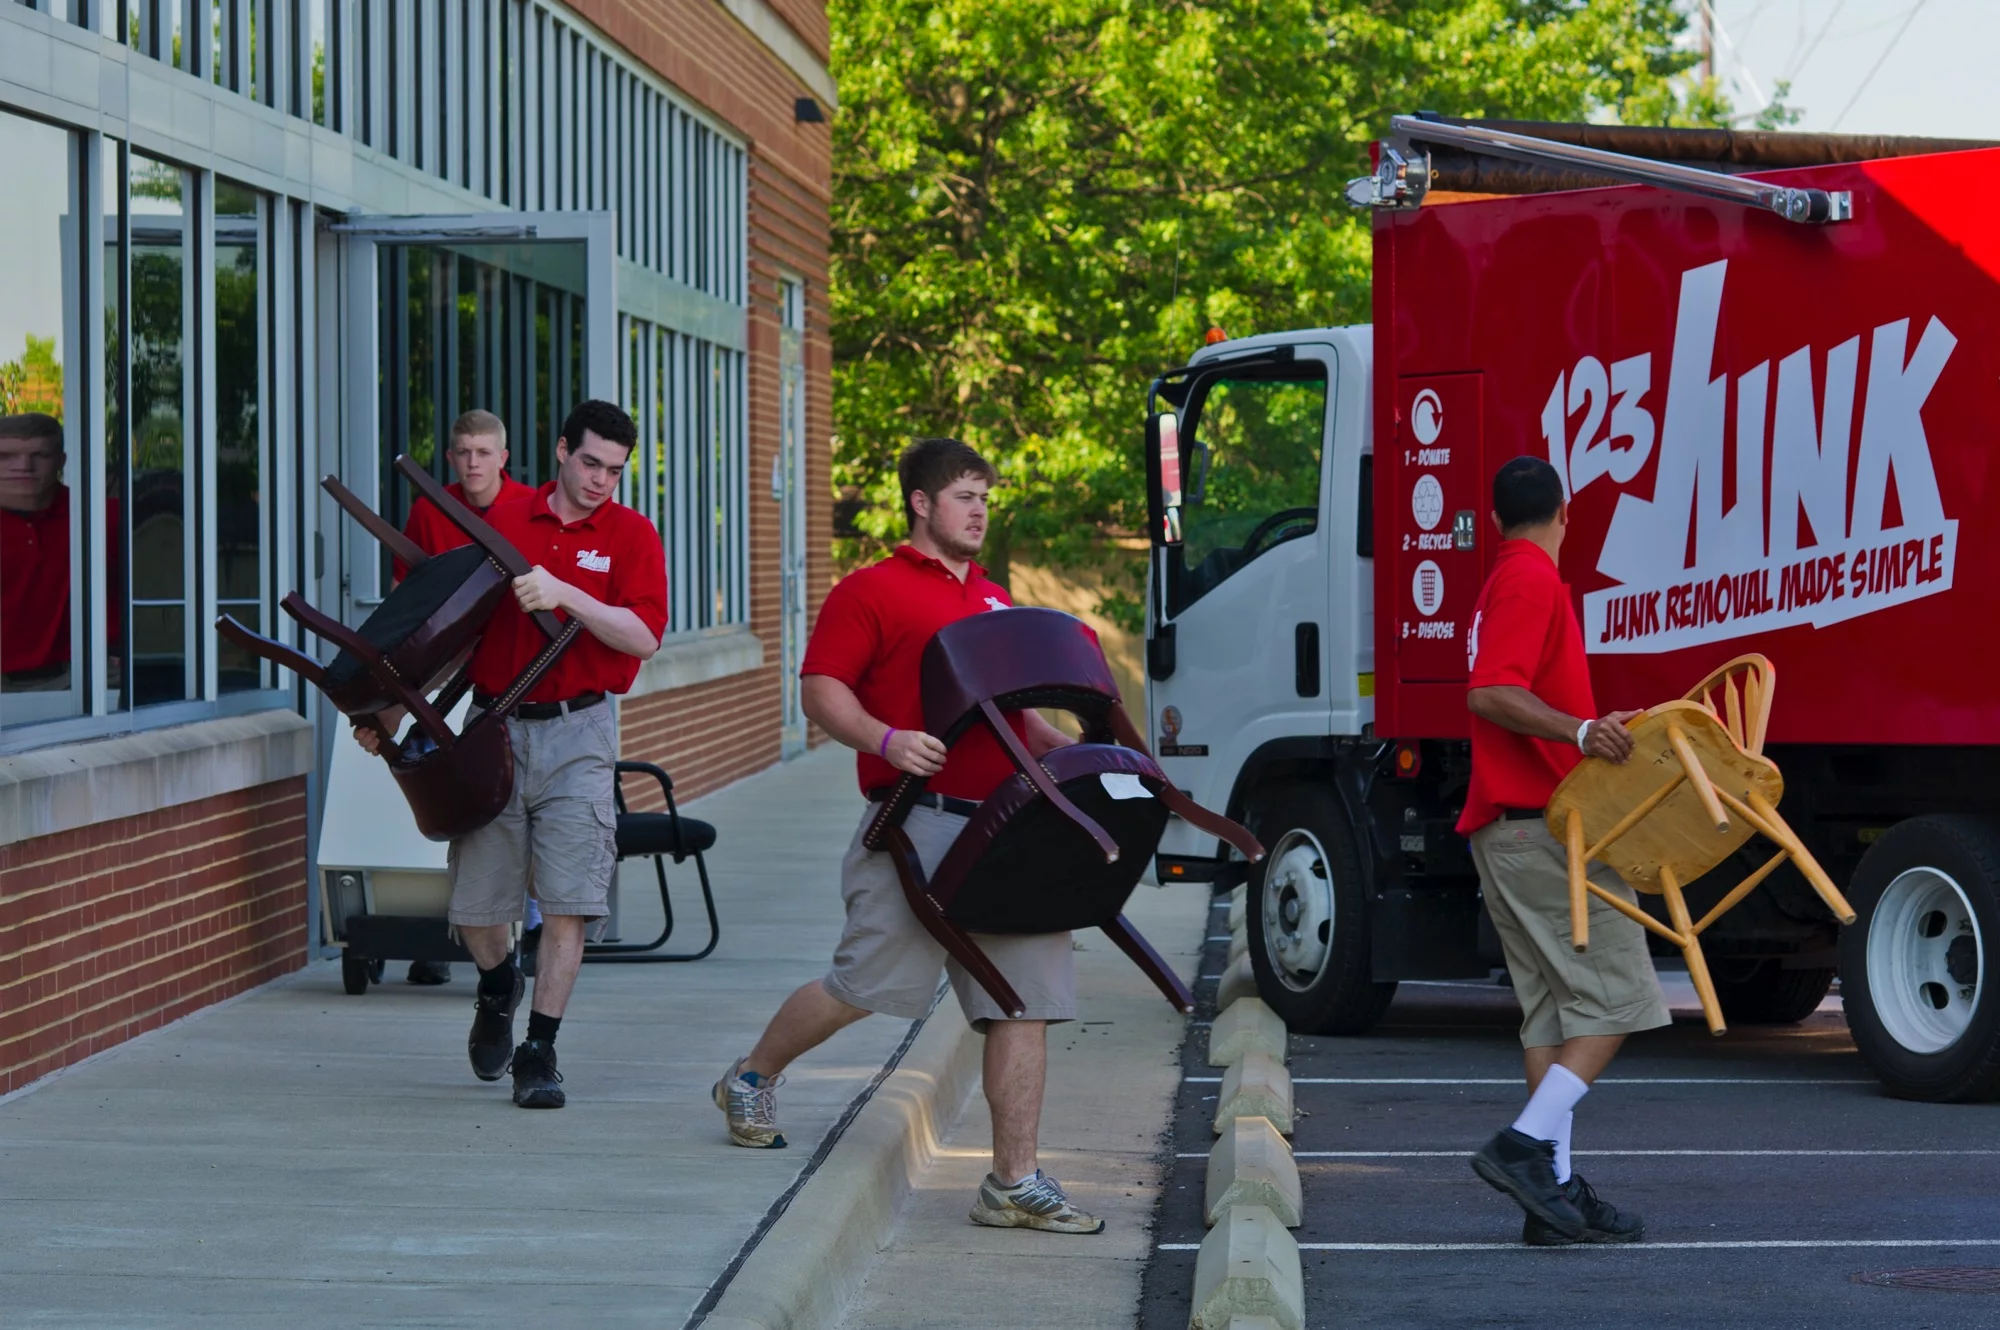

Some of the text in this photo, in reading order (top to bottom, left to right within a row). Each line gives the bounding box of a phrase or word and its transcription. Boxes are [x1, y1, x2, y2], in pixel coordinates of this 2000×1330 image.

[1541, 258, 1958, 584] 123 JUNK
[1404, 450, 1411, 466] 1
[1418, 448, 1450, 466] DONATE
[1402, 534, 1410, 551] 2
[1418, 533, 1453, 550] RECYCLE
[1600, 533, 1944, 643] JUNK REMOVAL MADE SIMPLE
[1402, 621, 1409, 639] 3
[1417, 621, 1455, 639] DISPOSE
